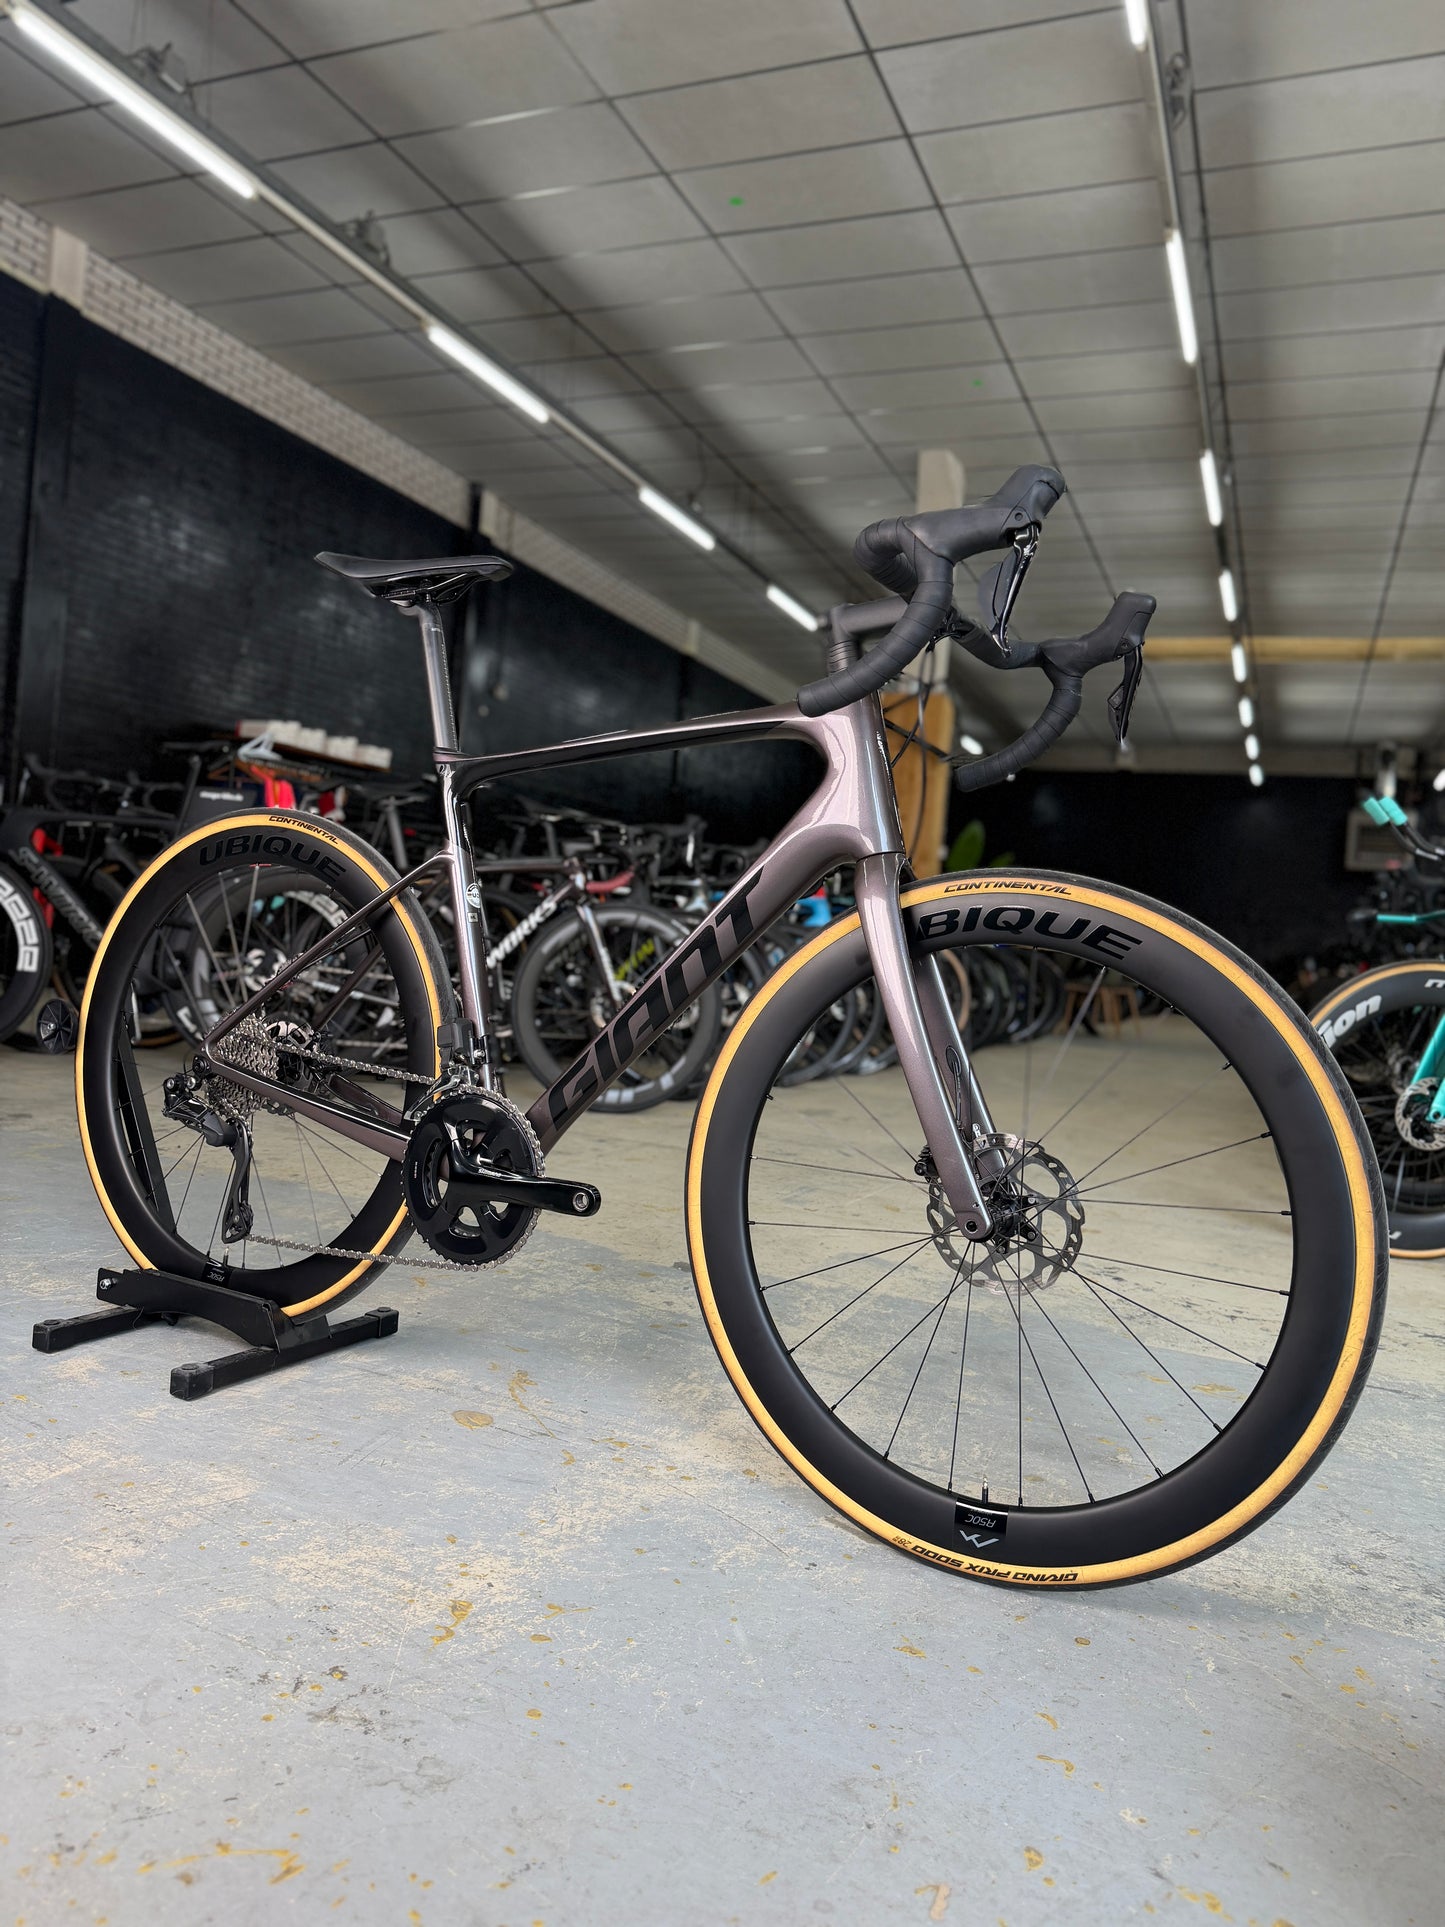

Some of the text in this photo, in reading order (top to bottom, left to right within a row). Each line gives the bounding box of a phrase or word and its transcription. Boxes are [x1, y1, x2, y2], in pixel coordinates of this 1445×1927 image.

[268, 815, 339, 845] CONTINENTAL
[200, 834, 347, 887] UBIQUE
[943, 881, 1072, 895] CONTINENTAL
[911, 1545, 964, 1568] 5000
[967, 1562, 1012, 1579] PRIX
[1013, 1571, 1079, 1583] GRAND
